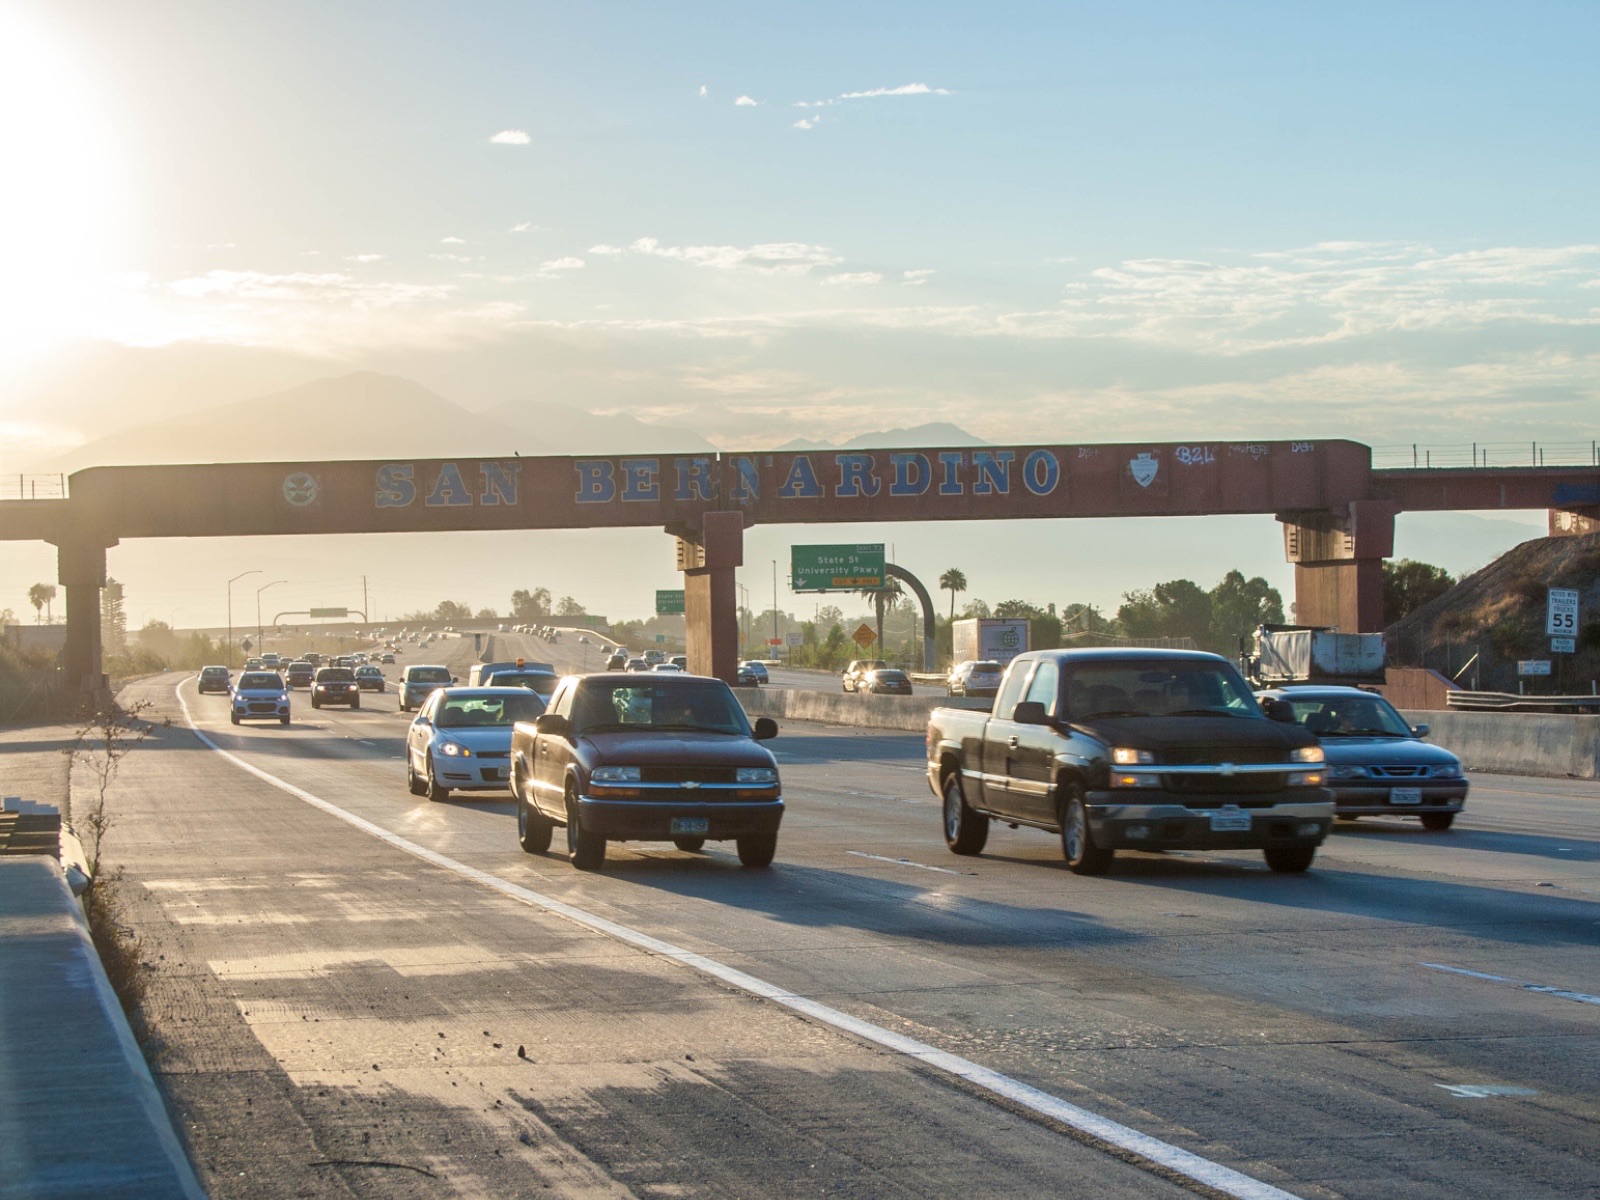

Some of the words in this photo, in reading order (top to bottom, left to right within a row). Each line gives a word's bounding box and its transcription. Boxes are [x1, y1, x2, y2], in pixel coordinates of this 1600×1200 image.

[374, 460, 522, 508] SAN
[574, 449, 1061, 506] BERNARDINO
[817, 556, 844, 564] State
[848, 555, 859, 564] St
[797, 566, 849, 575] University
[853, 566, 879, 575] Pkwy
[1553, 613, 1574, 628] 55
